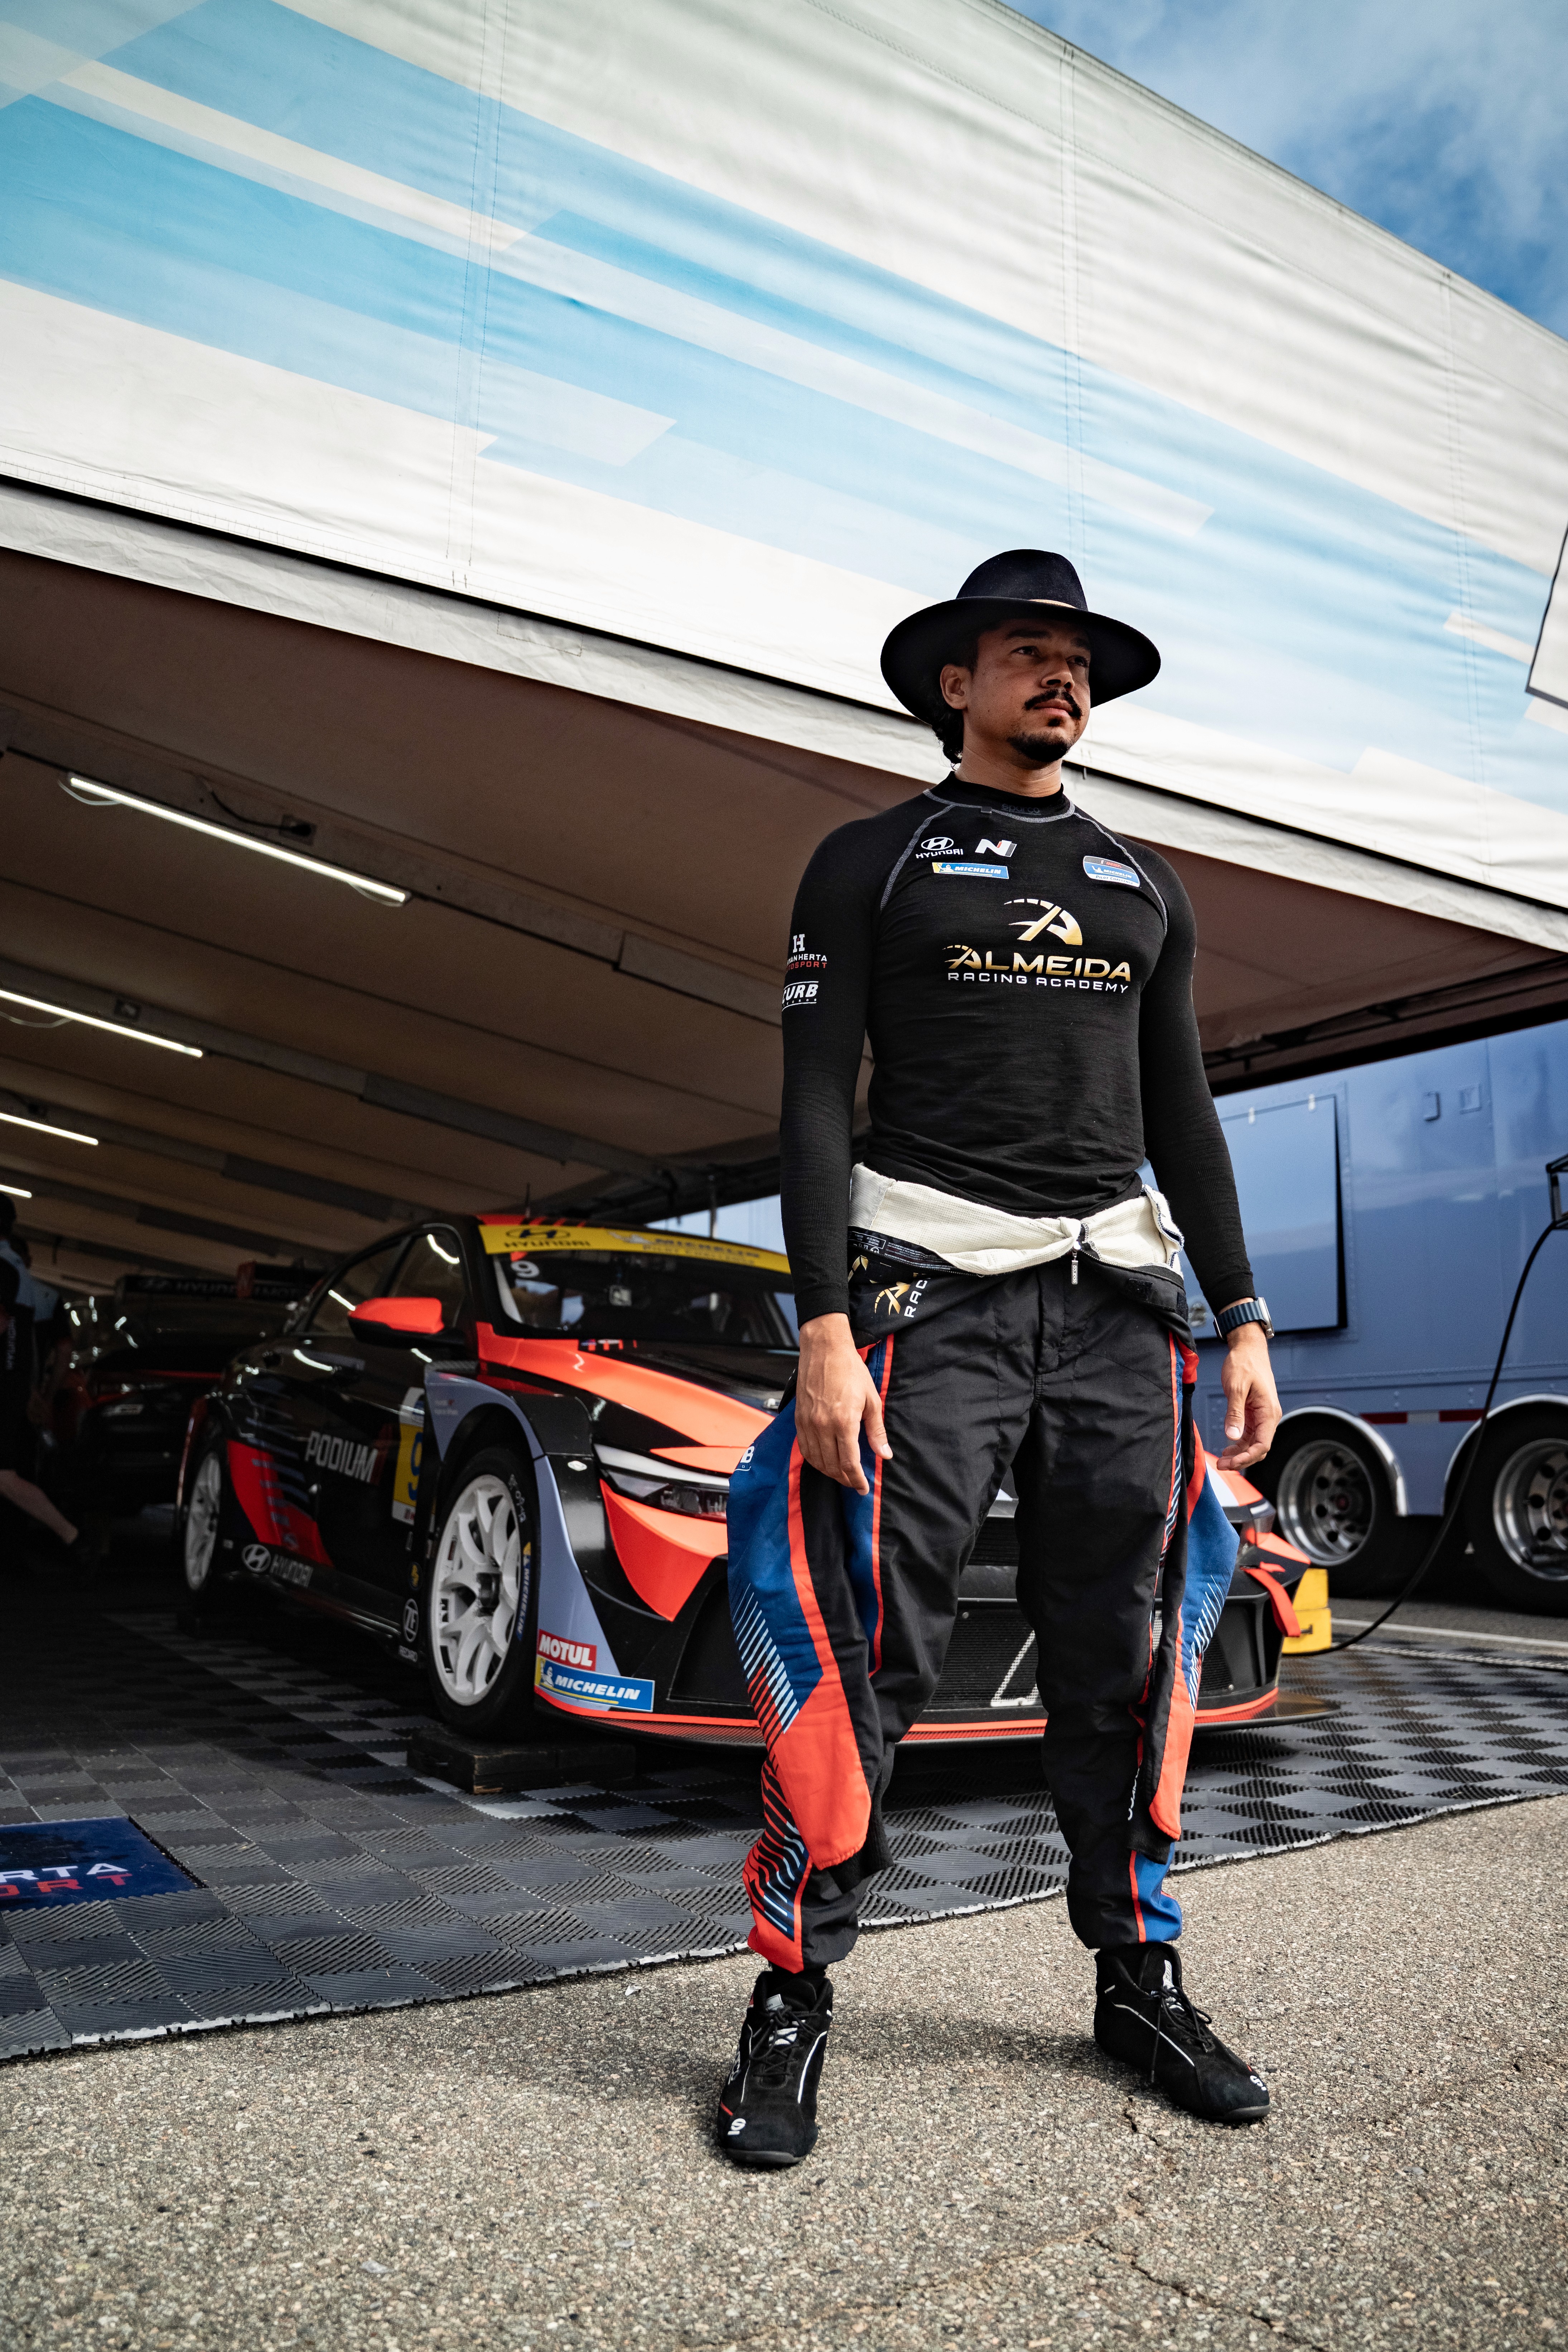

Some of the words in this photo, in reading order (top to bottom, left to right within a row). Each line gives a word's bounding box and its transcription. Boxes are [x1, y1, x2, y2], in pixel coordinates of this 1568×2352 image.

[1002, 803, 1040, 814] sparco
[916, 849, 963, 859] HYUNDAI
[954, 866, 1001, 874] MICHELIN
[1103, 869, 1132, 878] MICHELIN
[1110, 876, 1133, 885] CHALLENGE
[942, 945, 1131, 982] ALMEIDA
[948, 972, 1027, 984] RACING
[1036, 977, 1128, 994] ACADEMY
[782, 984, 818, 1004] CURB
[511, 1260, 540, 1278] 9
[305, 1431, 378, 1483] PODIUM
[517, 1568, 530, 1634] MICHELIN
[539, 1634, 593, 1667] MOTUL
[555, 1675, 640, 1700] MICHELIN
